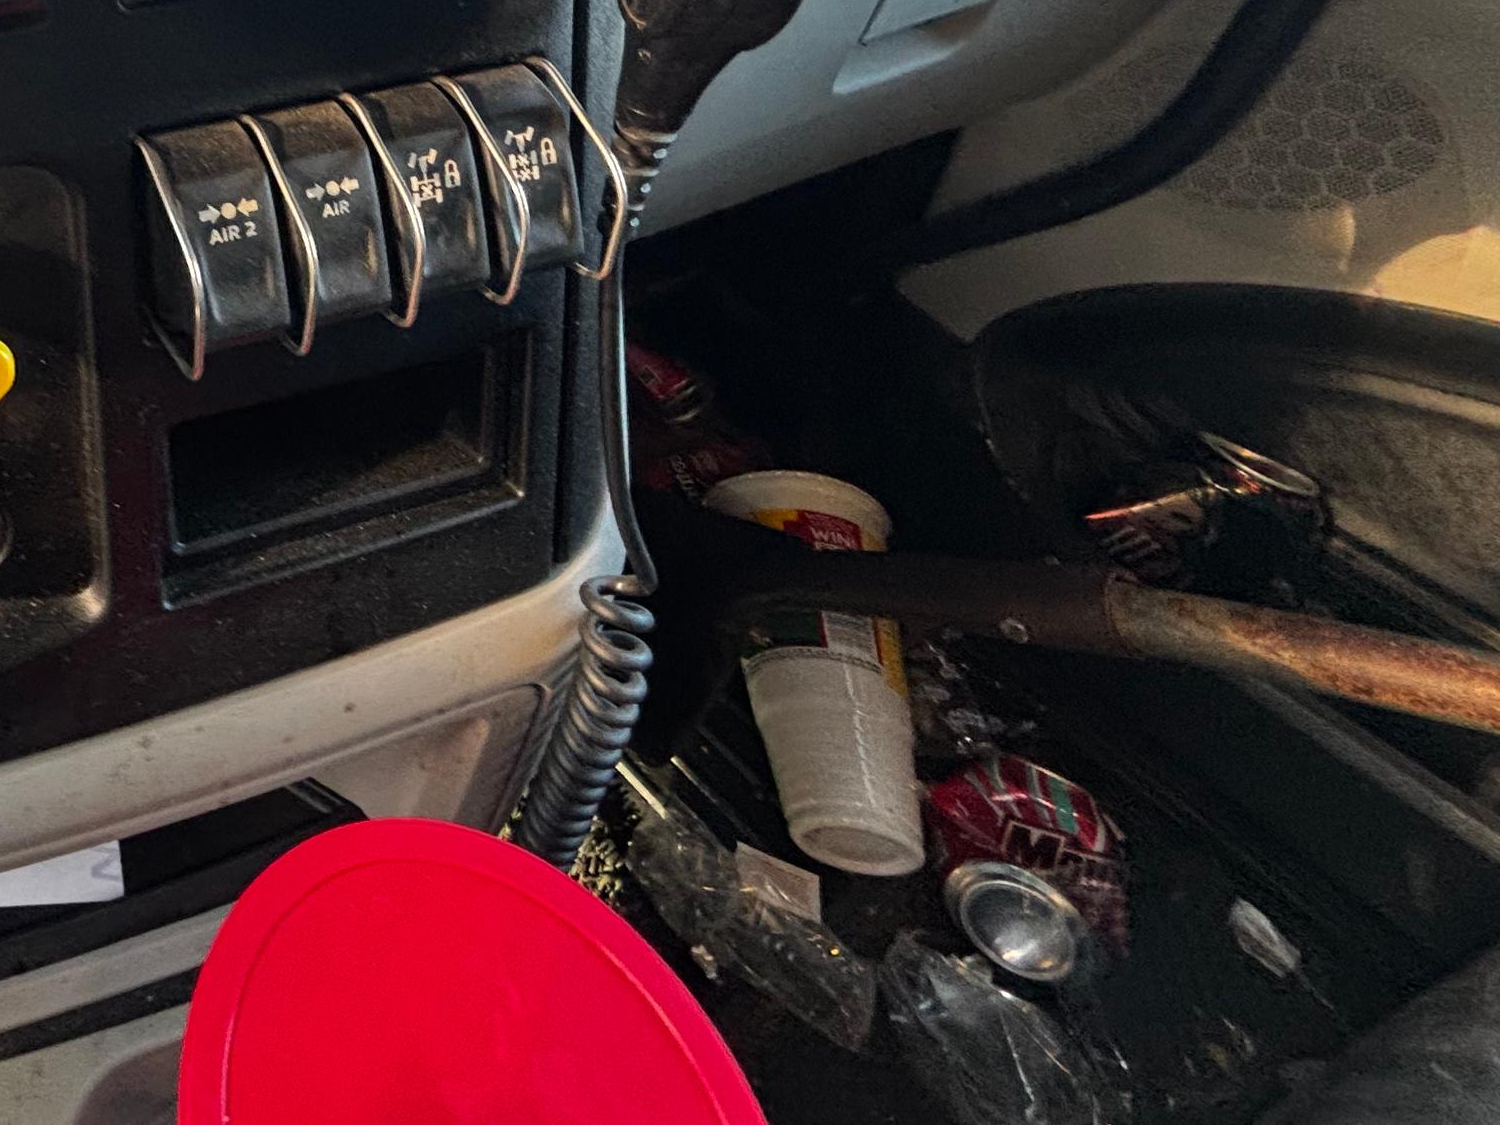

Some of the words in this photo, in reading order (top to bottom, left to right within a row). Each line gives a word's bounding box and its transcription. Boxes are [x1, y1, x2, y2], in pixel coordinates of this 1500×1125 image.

[322, 198, 351, 219] AIR
[209, 224, 242, 246] AIR
[243, 220, 259, 238] 2
